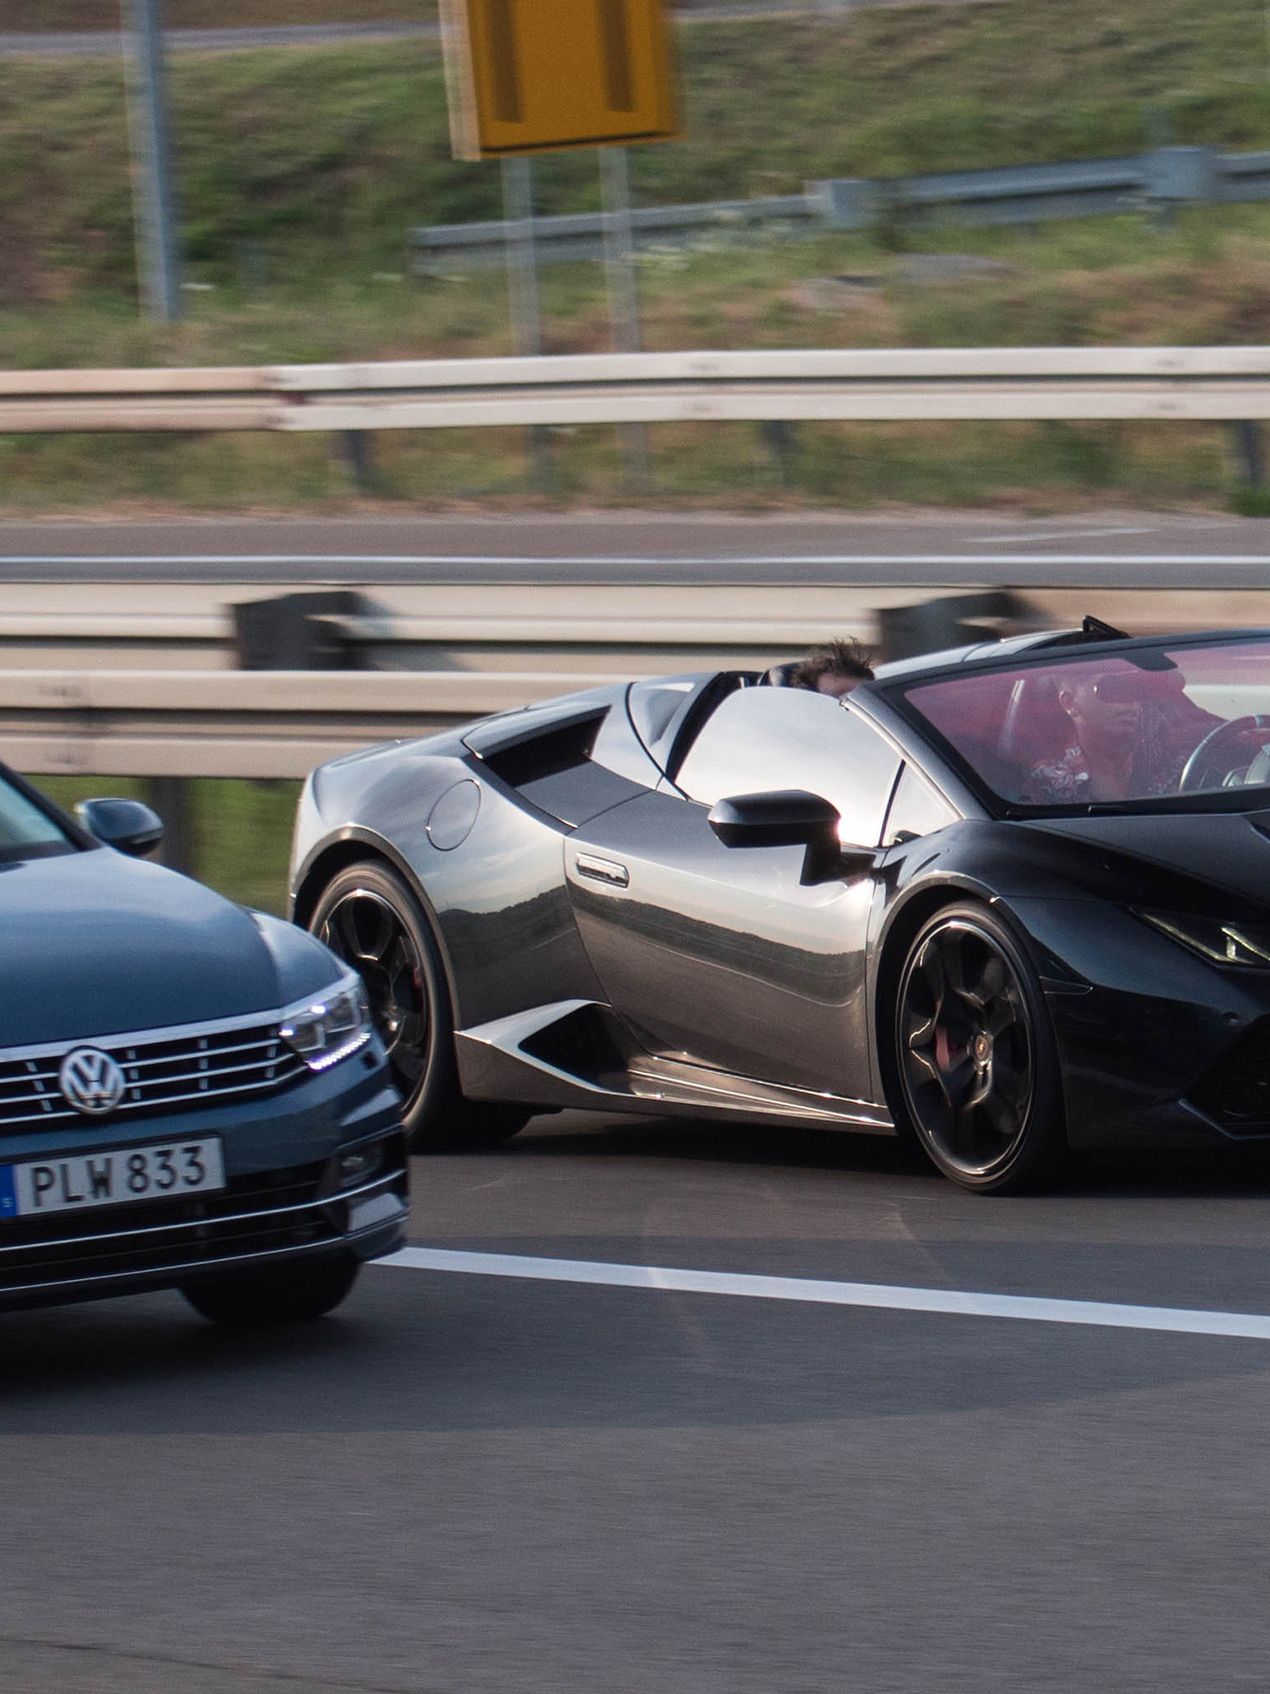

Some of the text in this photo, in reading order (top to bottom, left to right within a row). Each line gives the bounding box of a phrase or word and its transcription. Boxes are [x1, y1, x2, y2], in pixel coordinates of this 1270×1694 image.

[63, 1049, 121, 1112] VW
[30, 1146, 206, 1208] PLW 833
